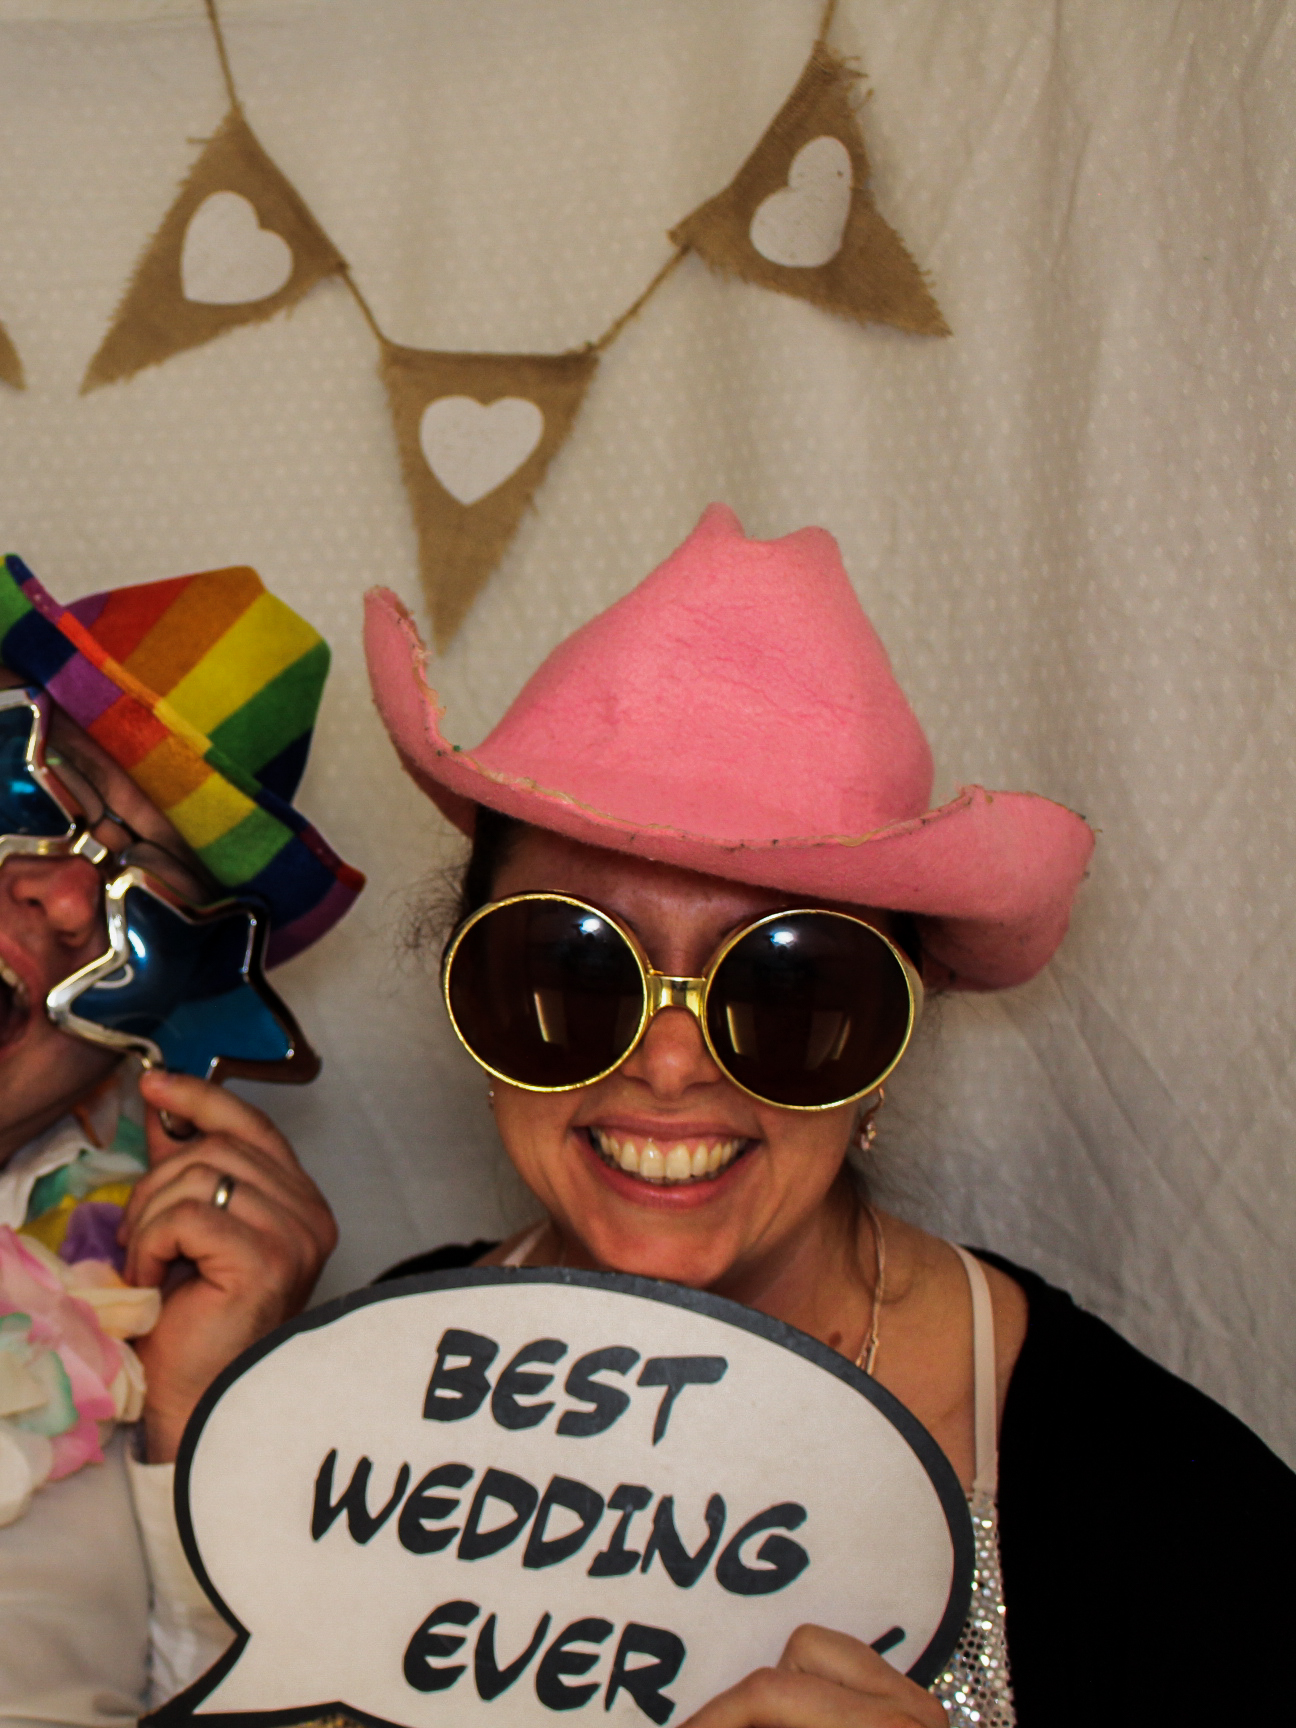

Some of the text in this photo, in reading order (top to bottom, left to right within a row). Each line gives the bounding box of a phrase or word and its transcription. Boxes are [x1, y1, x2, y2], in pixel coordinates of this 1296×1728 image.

[422, 1328, 728, 1446] BEST
[310, 1448, 810, 1597] WEDDING
[402, 1599, 687, 1727] EVER
